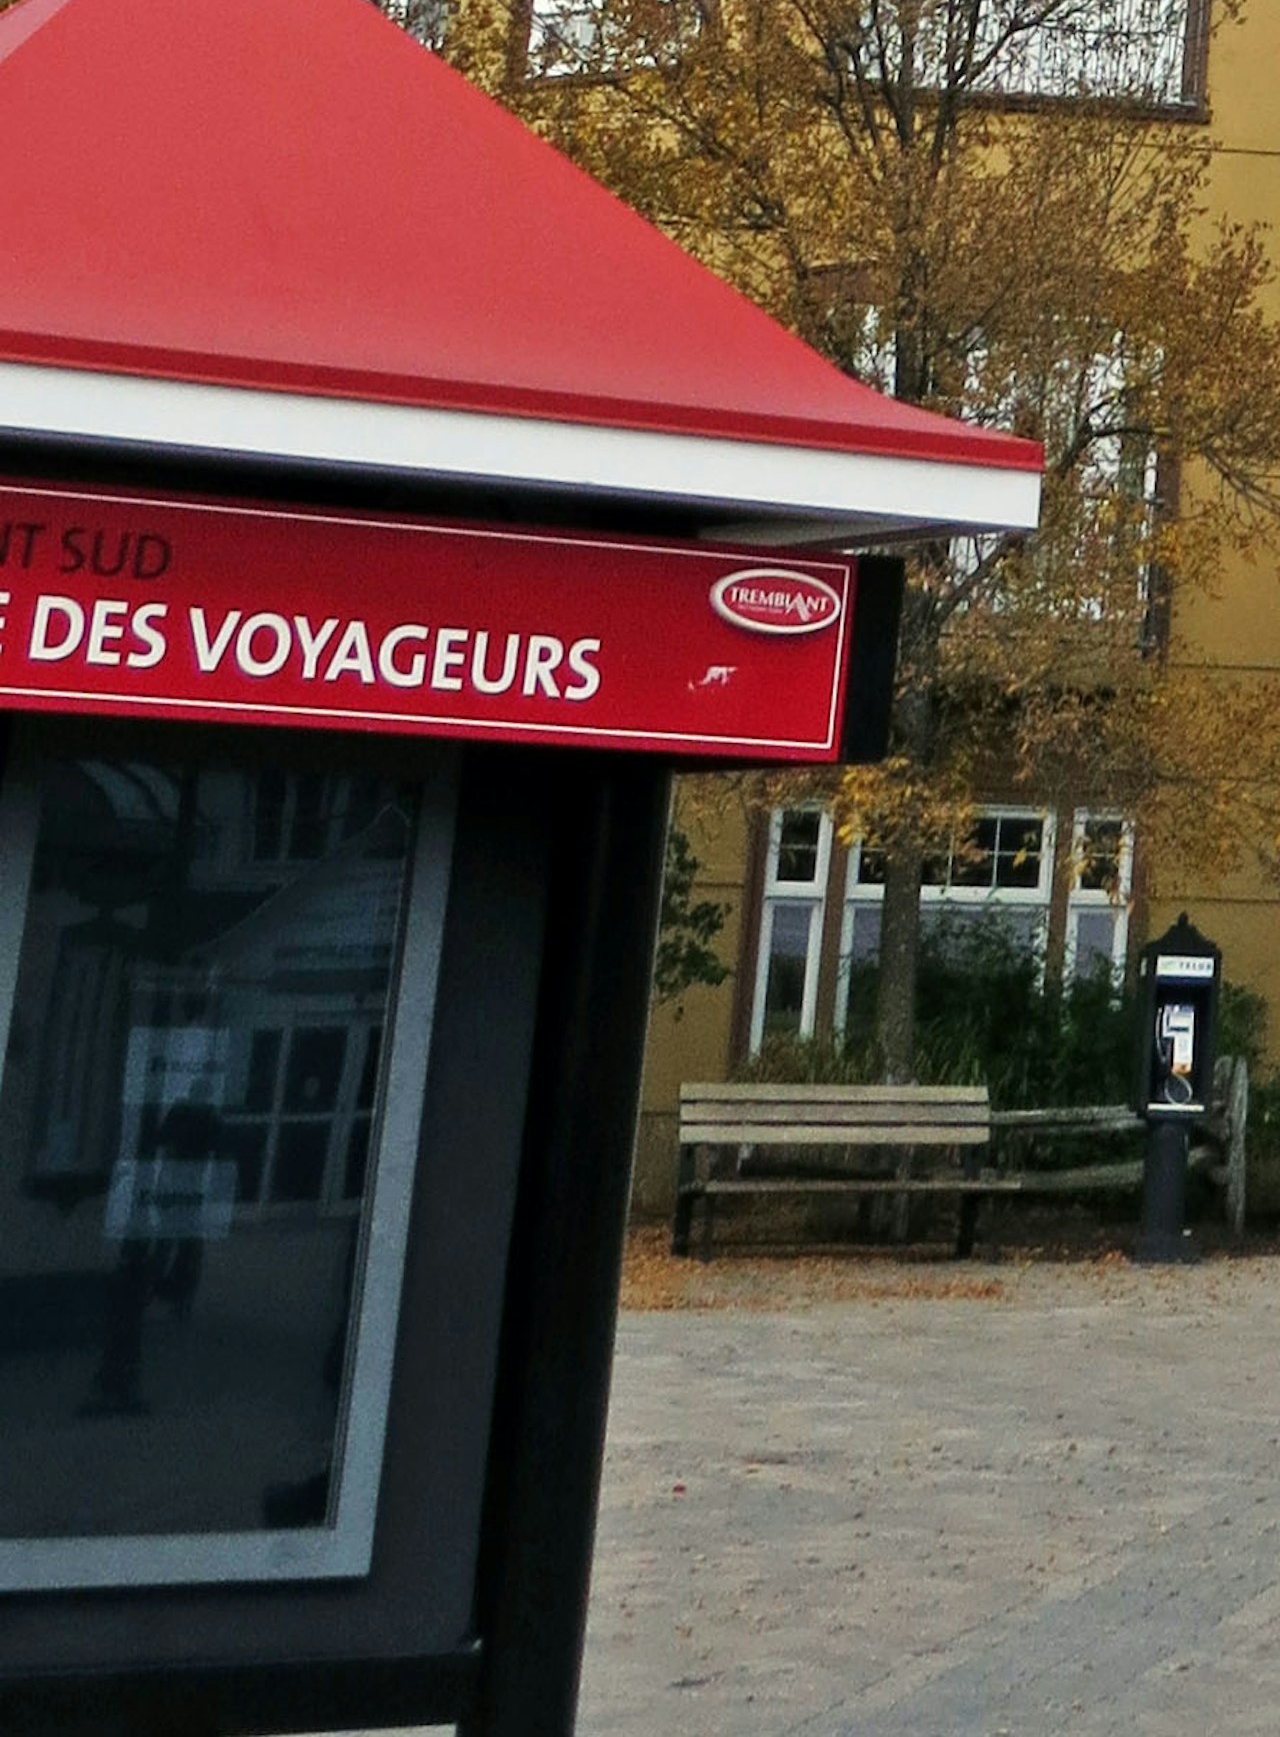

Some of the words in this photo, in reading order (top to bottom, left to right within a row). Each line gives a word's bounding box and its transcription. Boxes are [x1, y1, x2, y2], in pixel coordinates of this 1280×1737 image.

[60, 526, 173, 580] SUD
[730, 586, 829, 622] TREMBLANT
[28, 594, 169, 669] DES
[189, 607, 601, 701] VOYAGEURS
